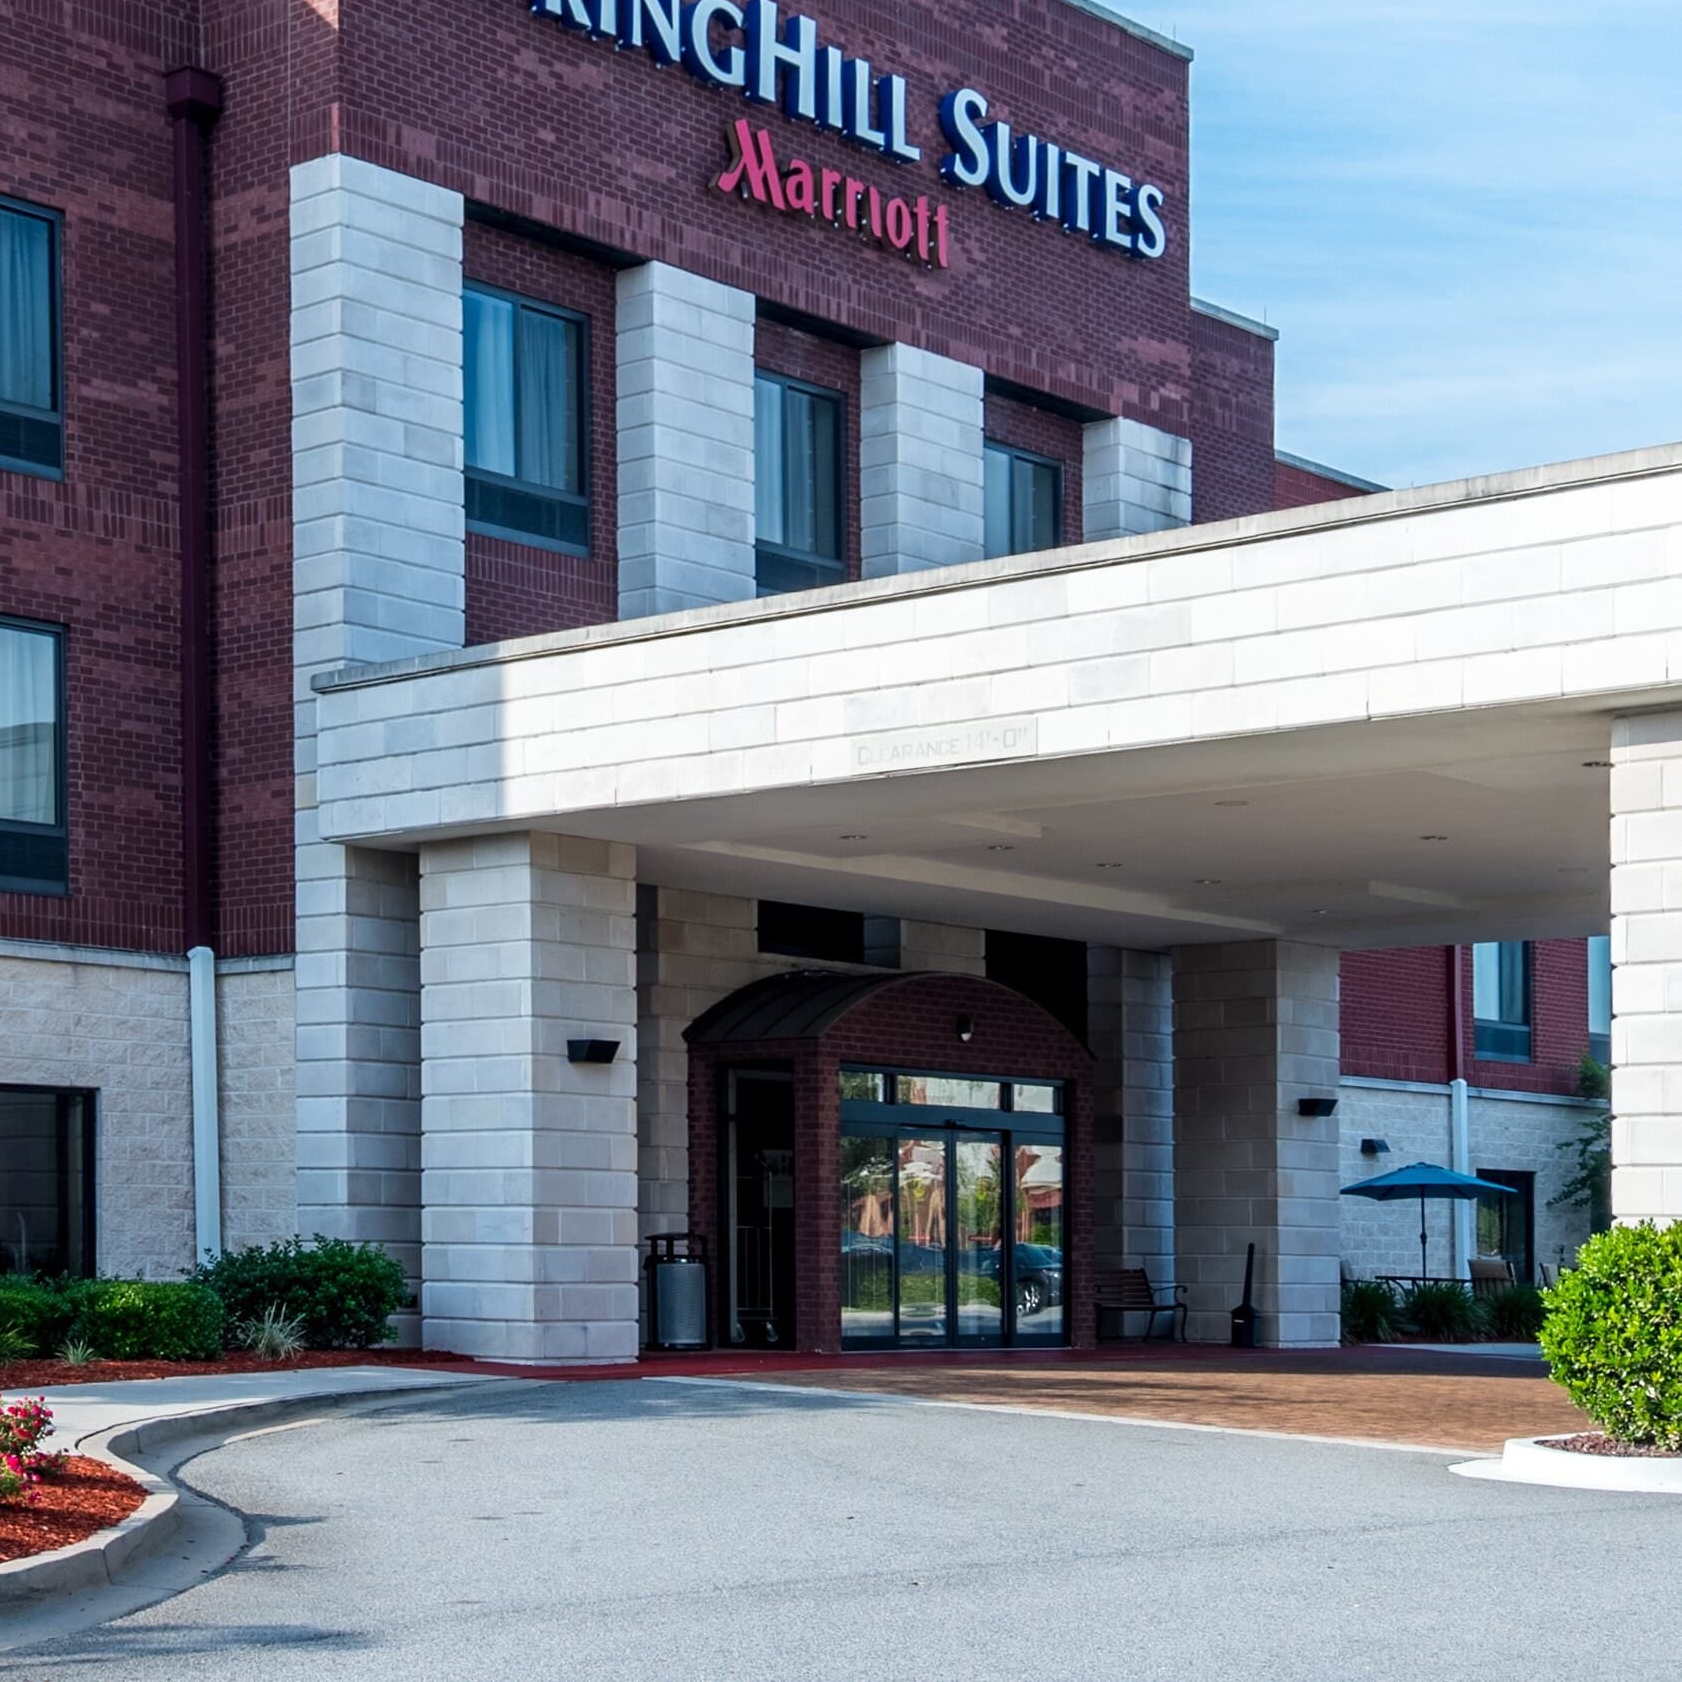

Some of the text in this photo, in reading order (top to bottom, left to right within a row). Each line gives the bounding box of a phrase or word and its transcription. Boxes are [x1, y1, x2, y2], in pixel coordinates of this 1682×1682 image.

[712, 118, 949, 269] Marriott
[939, 87, 1166, 260] SUITES
[858, 738, 959, 765] CLEARANCE
